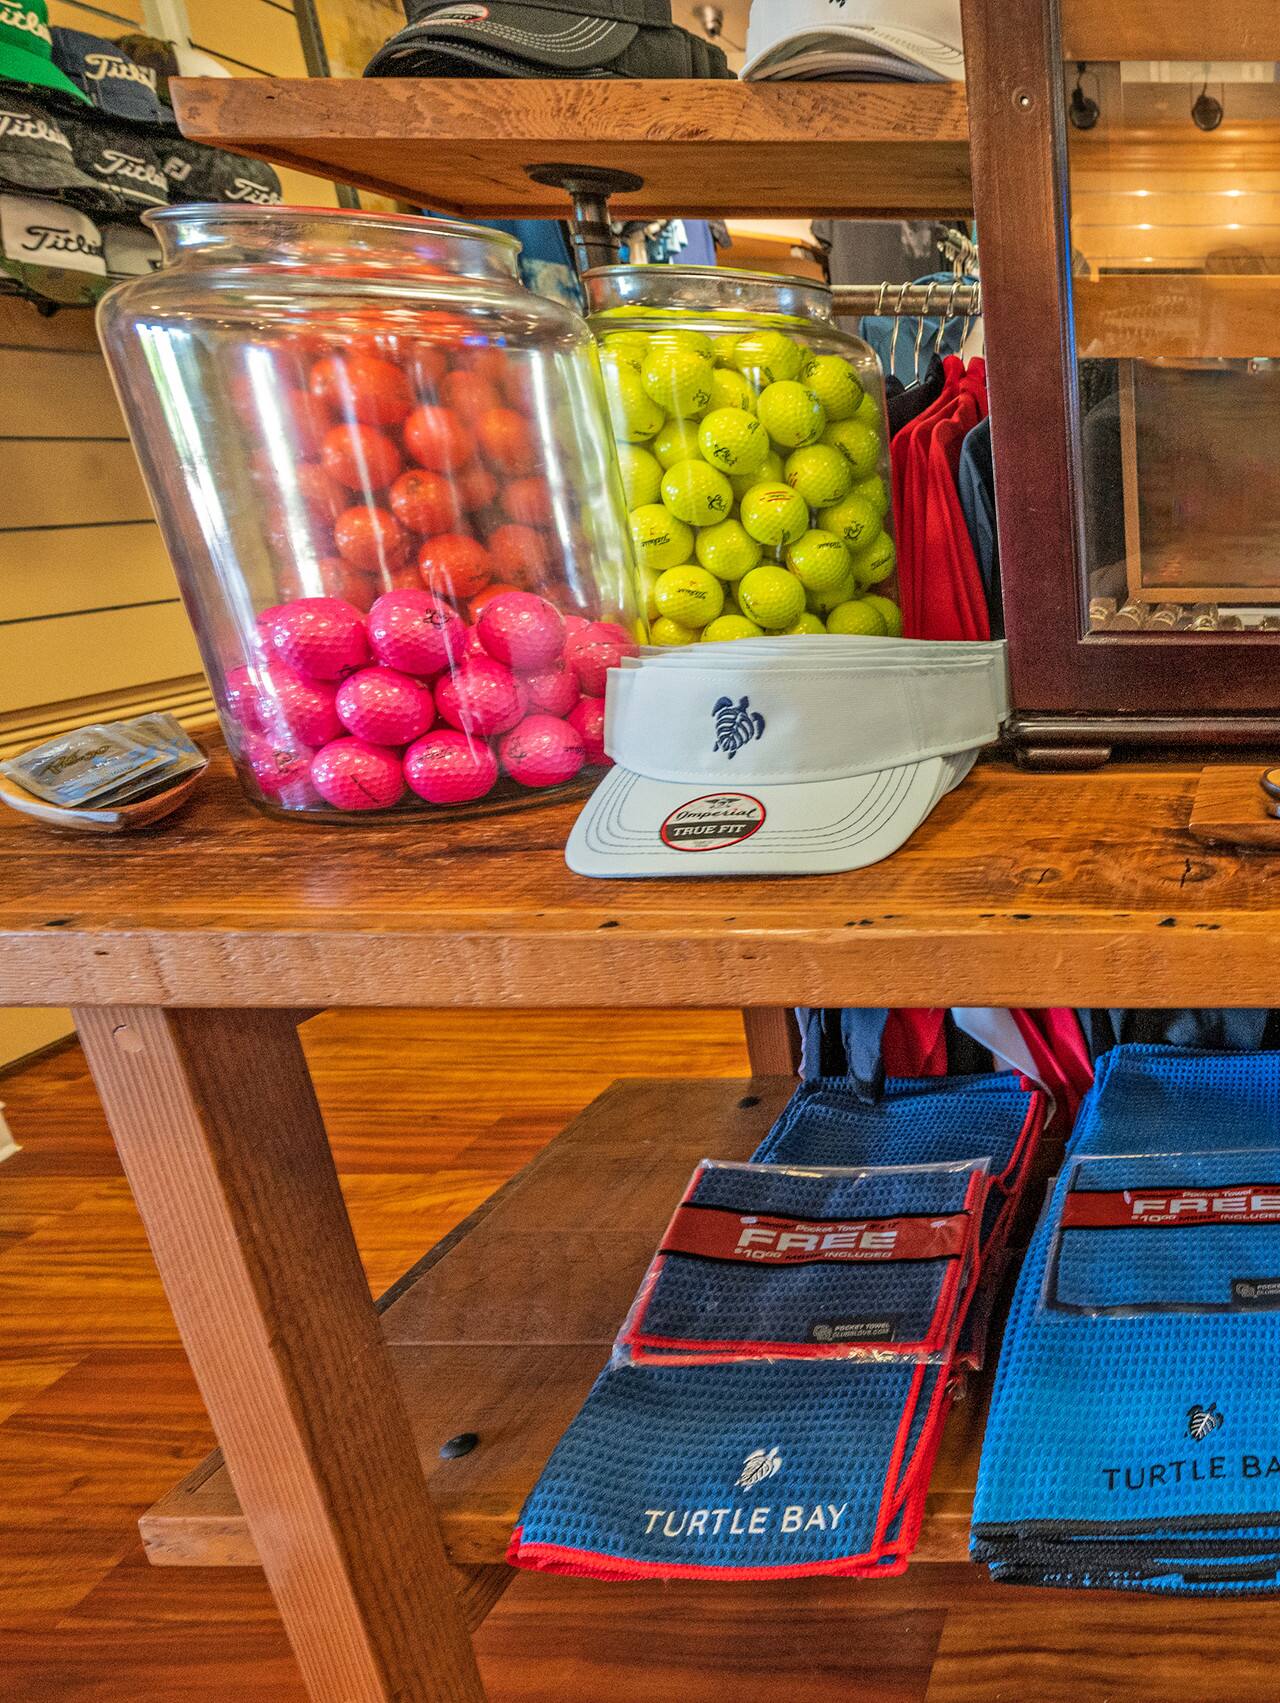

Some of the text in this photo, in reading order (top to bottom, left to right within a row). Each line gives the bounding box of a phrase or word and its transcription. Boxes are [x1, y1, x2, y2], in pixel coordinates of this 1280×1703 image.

[673, 824, 747, 836] TRUE FIT
[795, 1224, 834, 1232] Pocket
[837, 1223, 867, 1231] Towel
[737, 1228, 898, 1251] FREE
[824, 1251, 893, 1259] INCLUDED
[1102, 1456, 1226, 1490] TURTLE
[644, 1502, 848, 1537] TURTLE BAY
